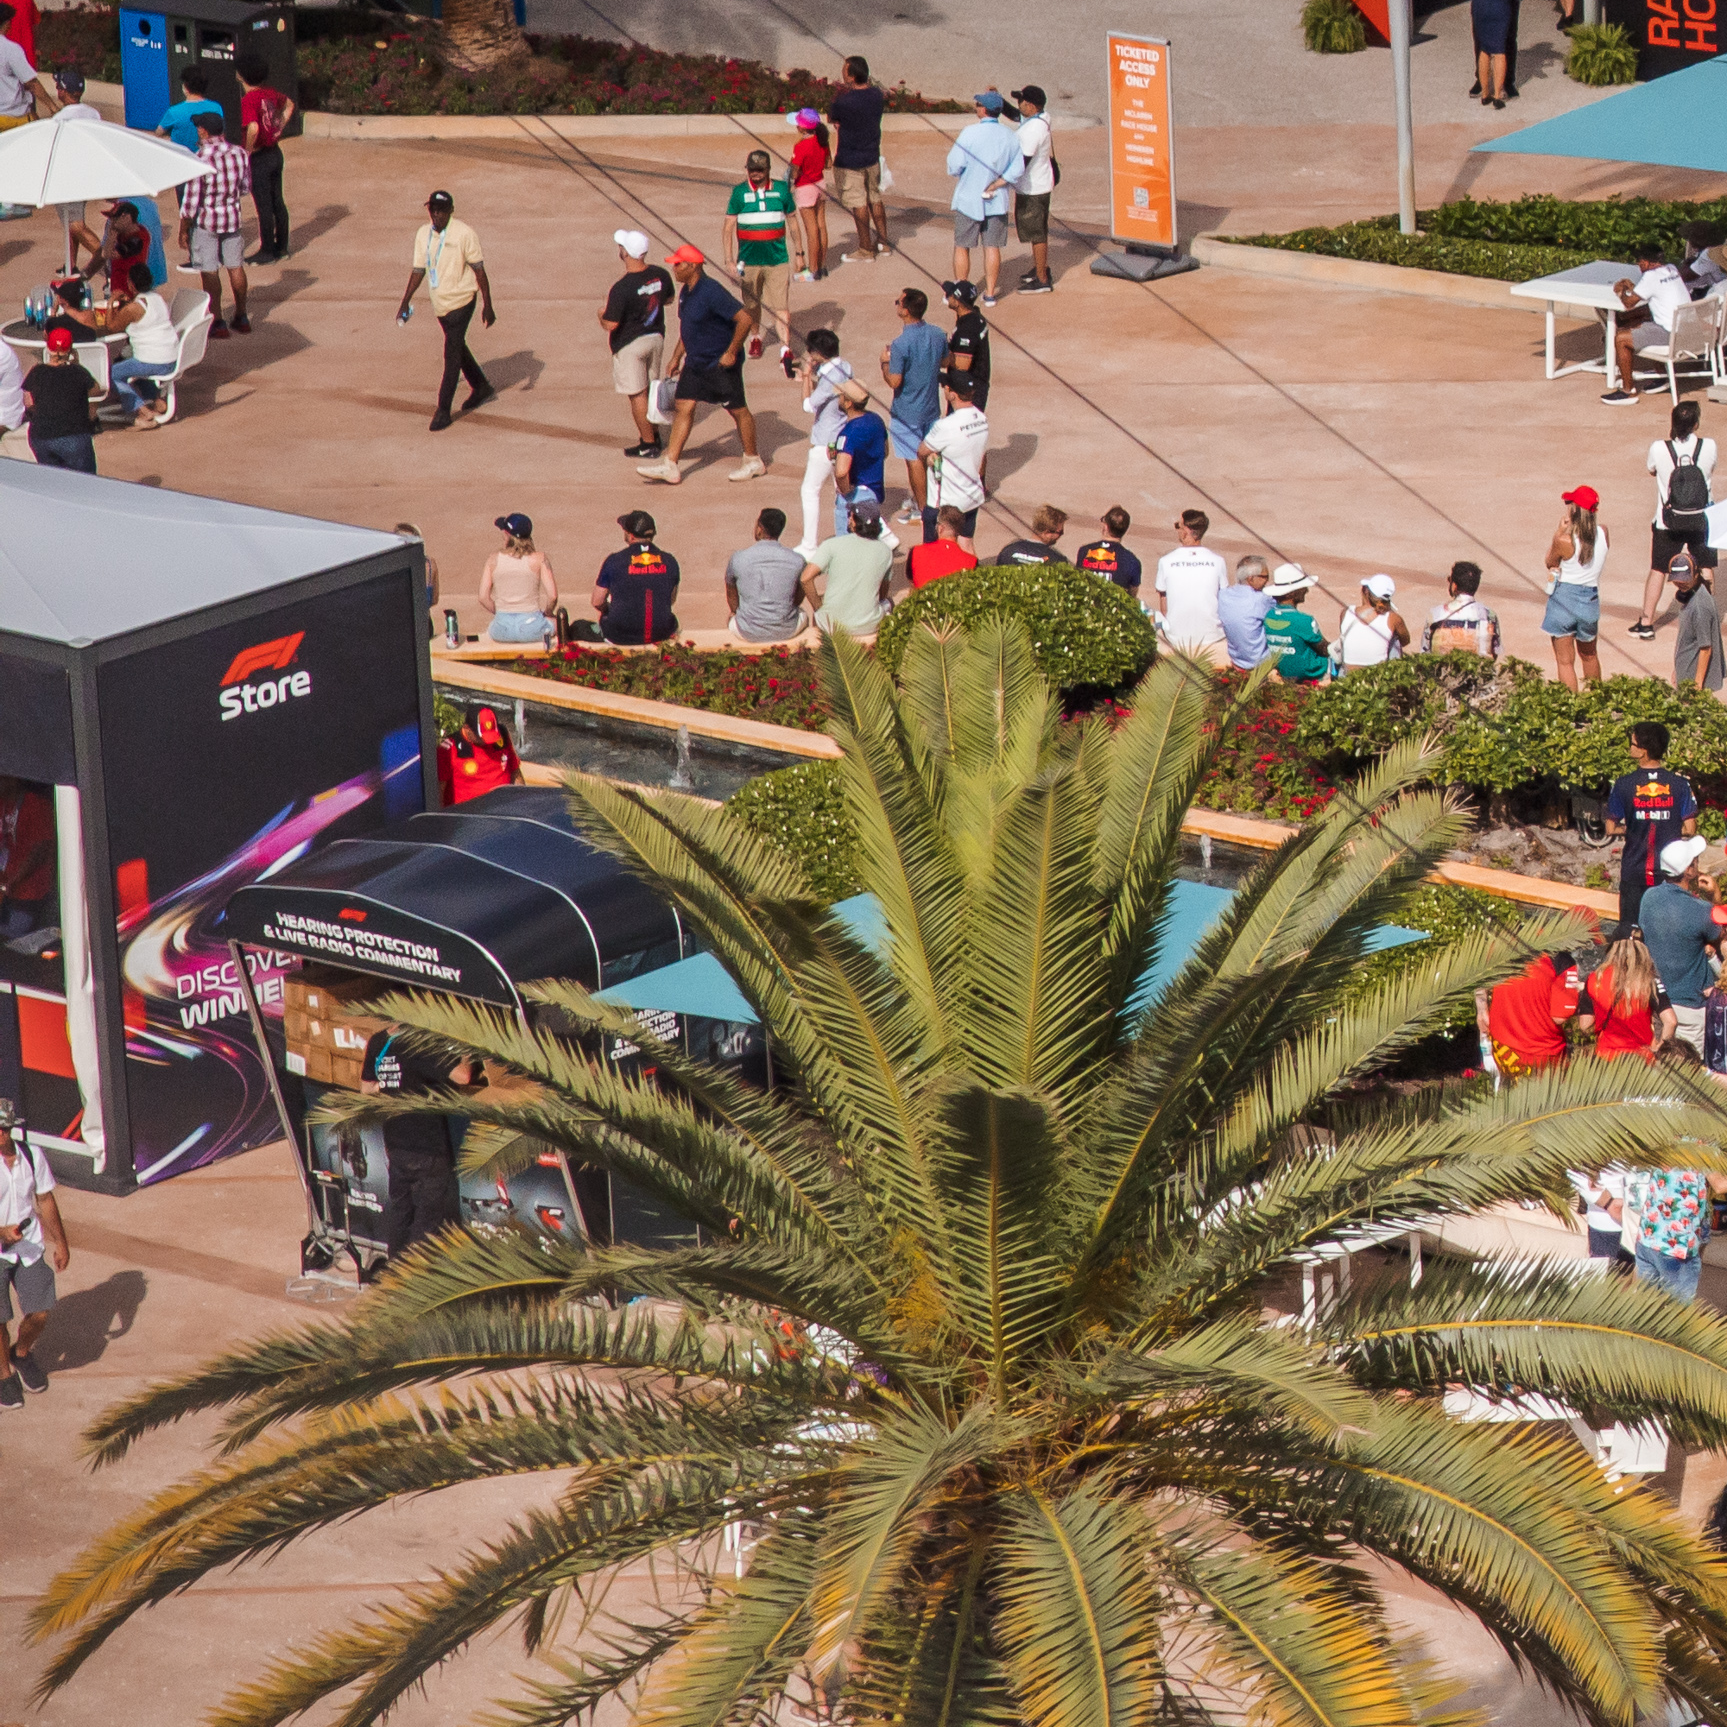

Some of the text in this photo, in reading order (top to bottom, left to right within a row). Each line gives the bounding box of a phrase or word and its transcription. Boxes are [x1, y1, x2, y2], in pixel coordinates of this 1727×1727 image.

[1115, 44, 1160, 63] TICKETED
[1119, 59, 1156, 76] ACCESS
[1125, 75, 1151, 89] ONLY
[1170, 559, 1215, 568] PETRONAS
[219, 670, 311, 722] Store
[1633, 796, 1674, 808] Red Bull
[1635, 810, 1660, 821] Mobil
[275, 911, 441, 962] HEARING PROTECTION
[263, 924, 461, 983] & LIVE RADIO COMMENTARY
[176, 950, 298, 1000] DISCOVE
